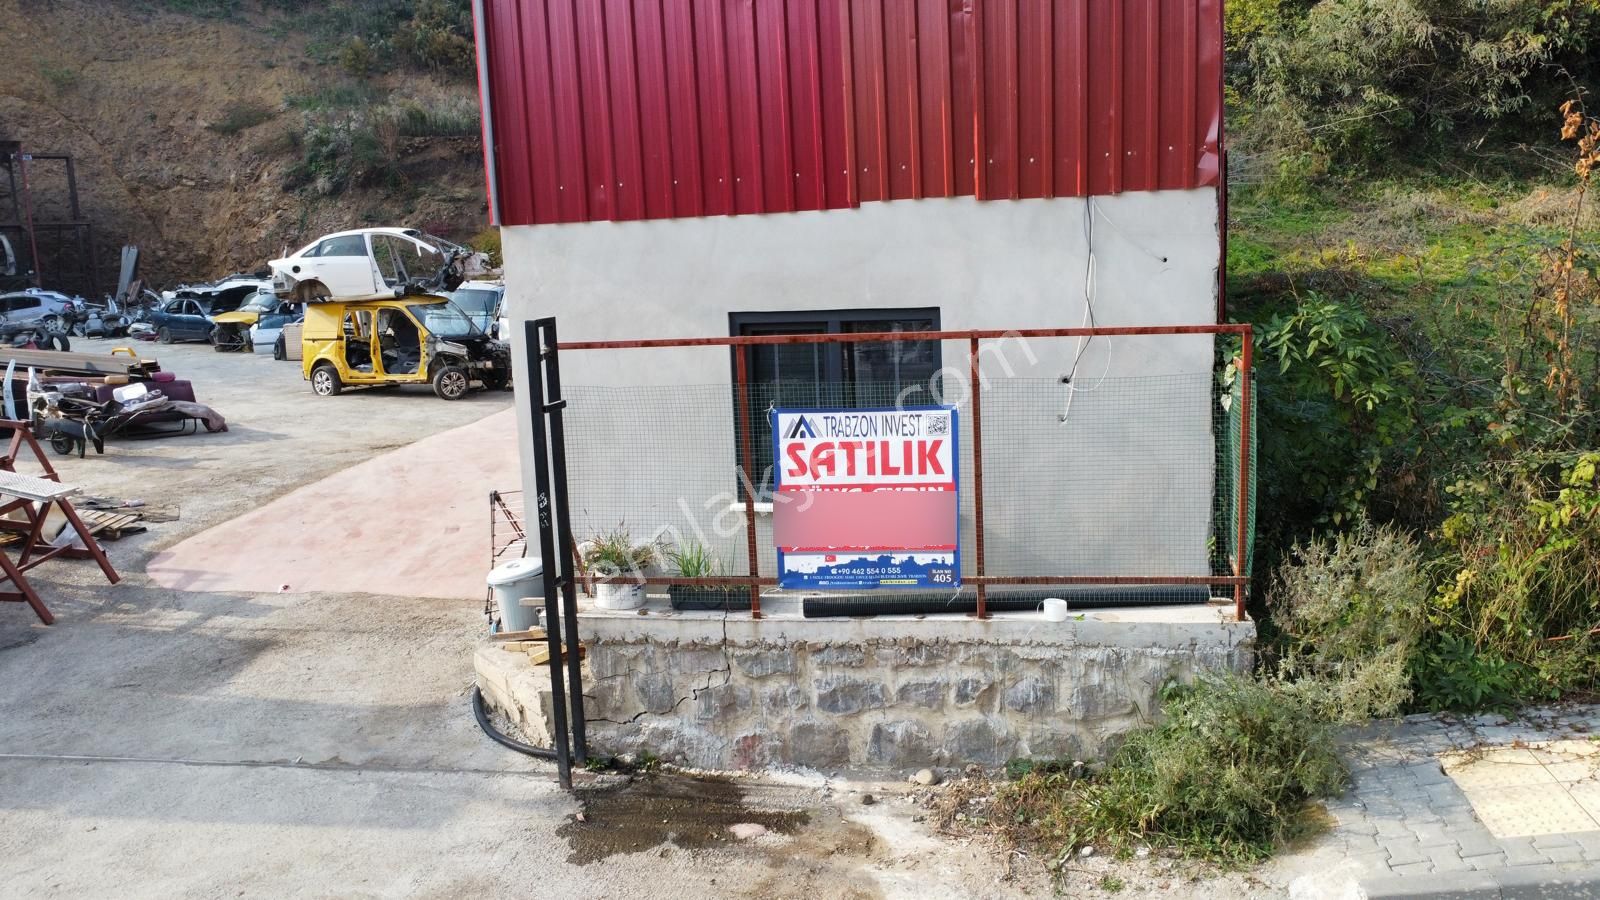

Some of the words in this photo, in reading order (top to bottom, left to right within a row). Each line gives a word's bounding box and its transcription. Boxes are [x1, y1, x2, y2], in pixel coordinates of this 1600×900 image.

[823, 415, 878, 438] TRABZON
[881, 414, 922, 437] INVEST
[786, 439, 945, 482] SATILIK
[866, 567, 879, 575] 554
[933, 574, 952, 583] 405
